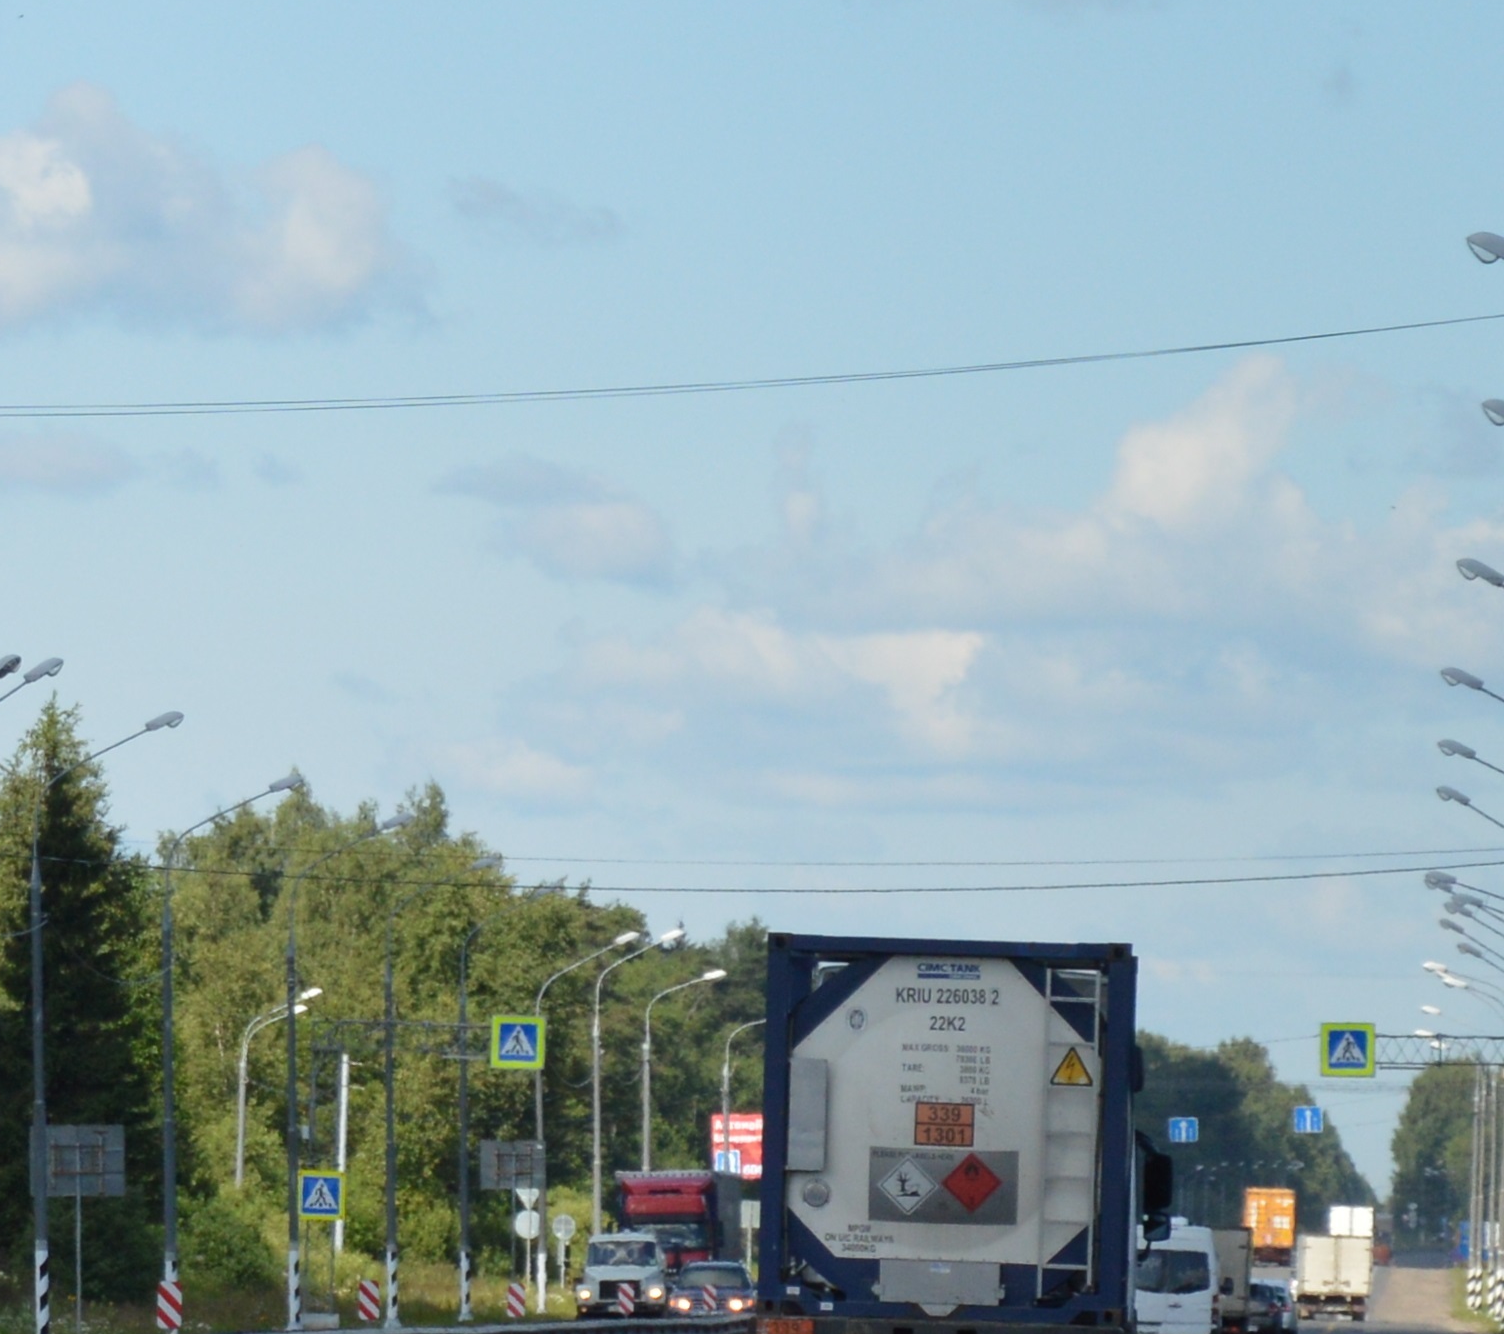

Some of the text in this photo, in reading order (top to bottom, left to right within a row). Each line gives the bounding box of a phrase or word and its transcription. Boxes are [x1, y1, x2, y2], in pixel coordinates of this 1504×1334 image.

[896, 987, 999, 1006] KRIU 226038 2
[929, 1015, 966, 1032] 22K2
[928, 1106, 962, 1123] 339
[923, 1127, 966, 1144] 1301
